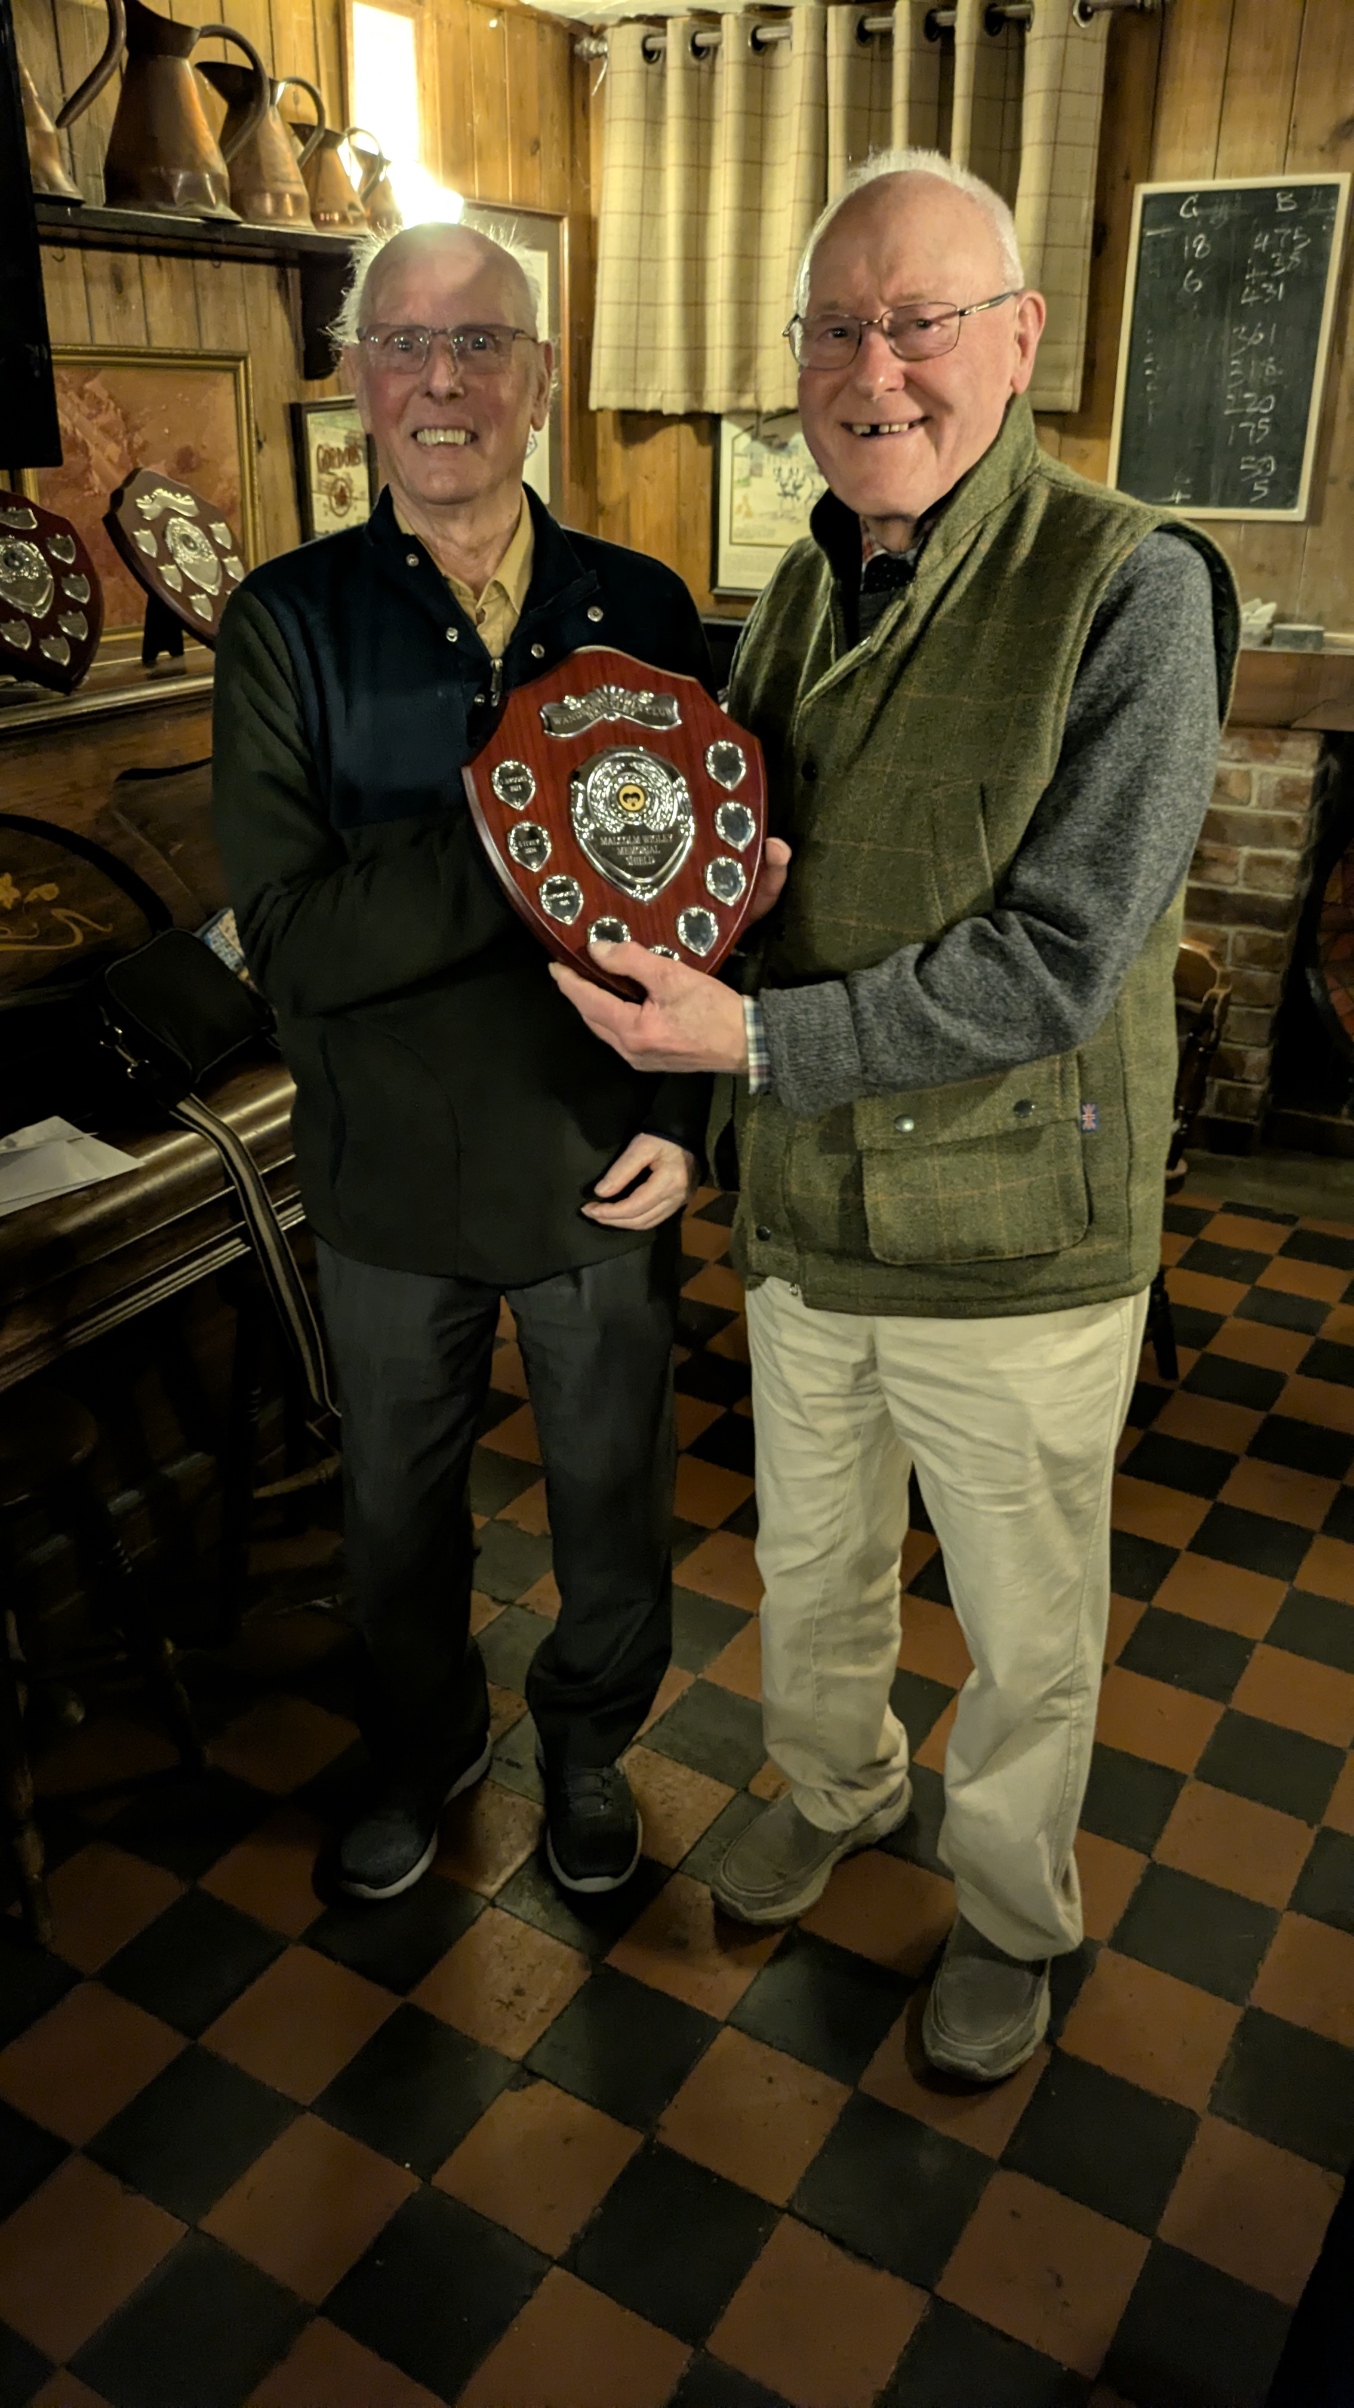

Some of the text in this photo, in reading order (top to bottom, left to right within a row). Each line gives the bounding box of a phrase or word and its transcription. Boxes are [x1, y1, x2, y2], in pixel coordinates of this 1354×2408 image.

[1275, 191, 1298, 213] B
[1184, 233, 1211, 259] 18
[1254, 225, 1311, 252] 475
[1183, 269, 1203, 292] 6
[1241, 282, 1284, 307] 431
[1227, 417, 1271, 446] 175
[1249, 479, 1270, 502] 5
[616, 844, 661, 856] MEMORIAL
